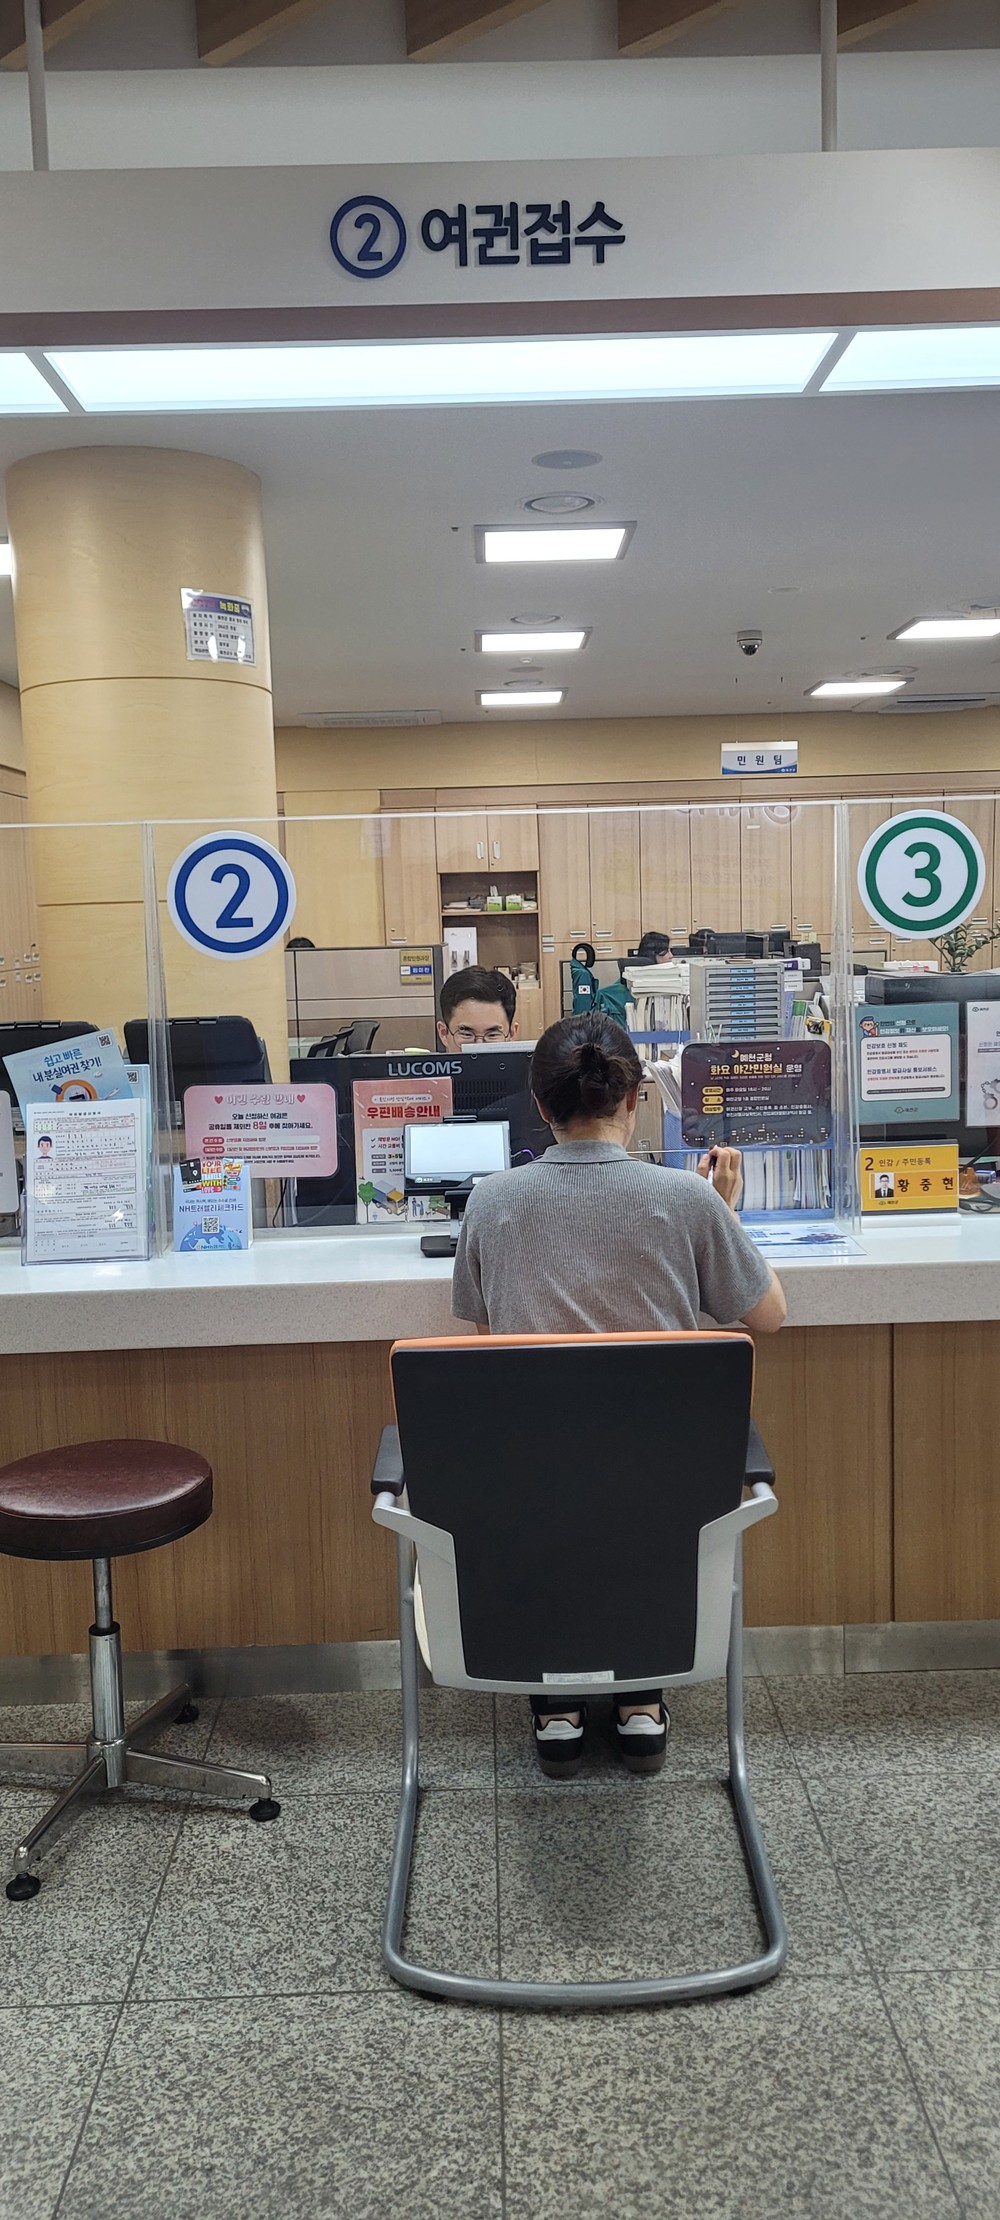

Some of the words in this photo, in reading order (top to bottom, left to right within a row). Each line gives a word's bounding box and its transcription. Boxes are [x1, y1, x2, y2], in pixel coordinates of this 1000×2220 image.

[420, 199, 627, 267] 여권접수
[44, 1053, 63, 1067] 쉽고
[63, 1047, 83, 1061] 빠른
[32, 1072, 44, 1083] 내
[44, 1062, 81, 1080] 분실여권
[80, 1056, 102, 1072] 찾기!
[388, 1060, 463, 1077] LUCOMS
[710, 1064, 731, 1076] 화요
[733, 1063, 783, 1075] 야간민원실
[785, 1063, 802, 1073] 운영
[252, 1121, 267, 1130] 8일
[864, 1156, 875, 1172] 2
[878, 1159, 894, 1168] 인감
[895, 1159, 900, 1167] /
[901, 1157, 932, 1167] 주민등록
